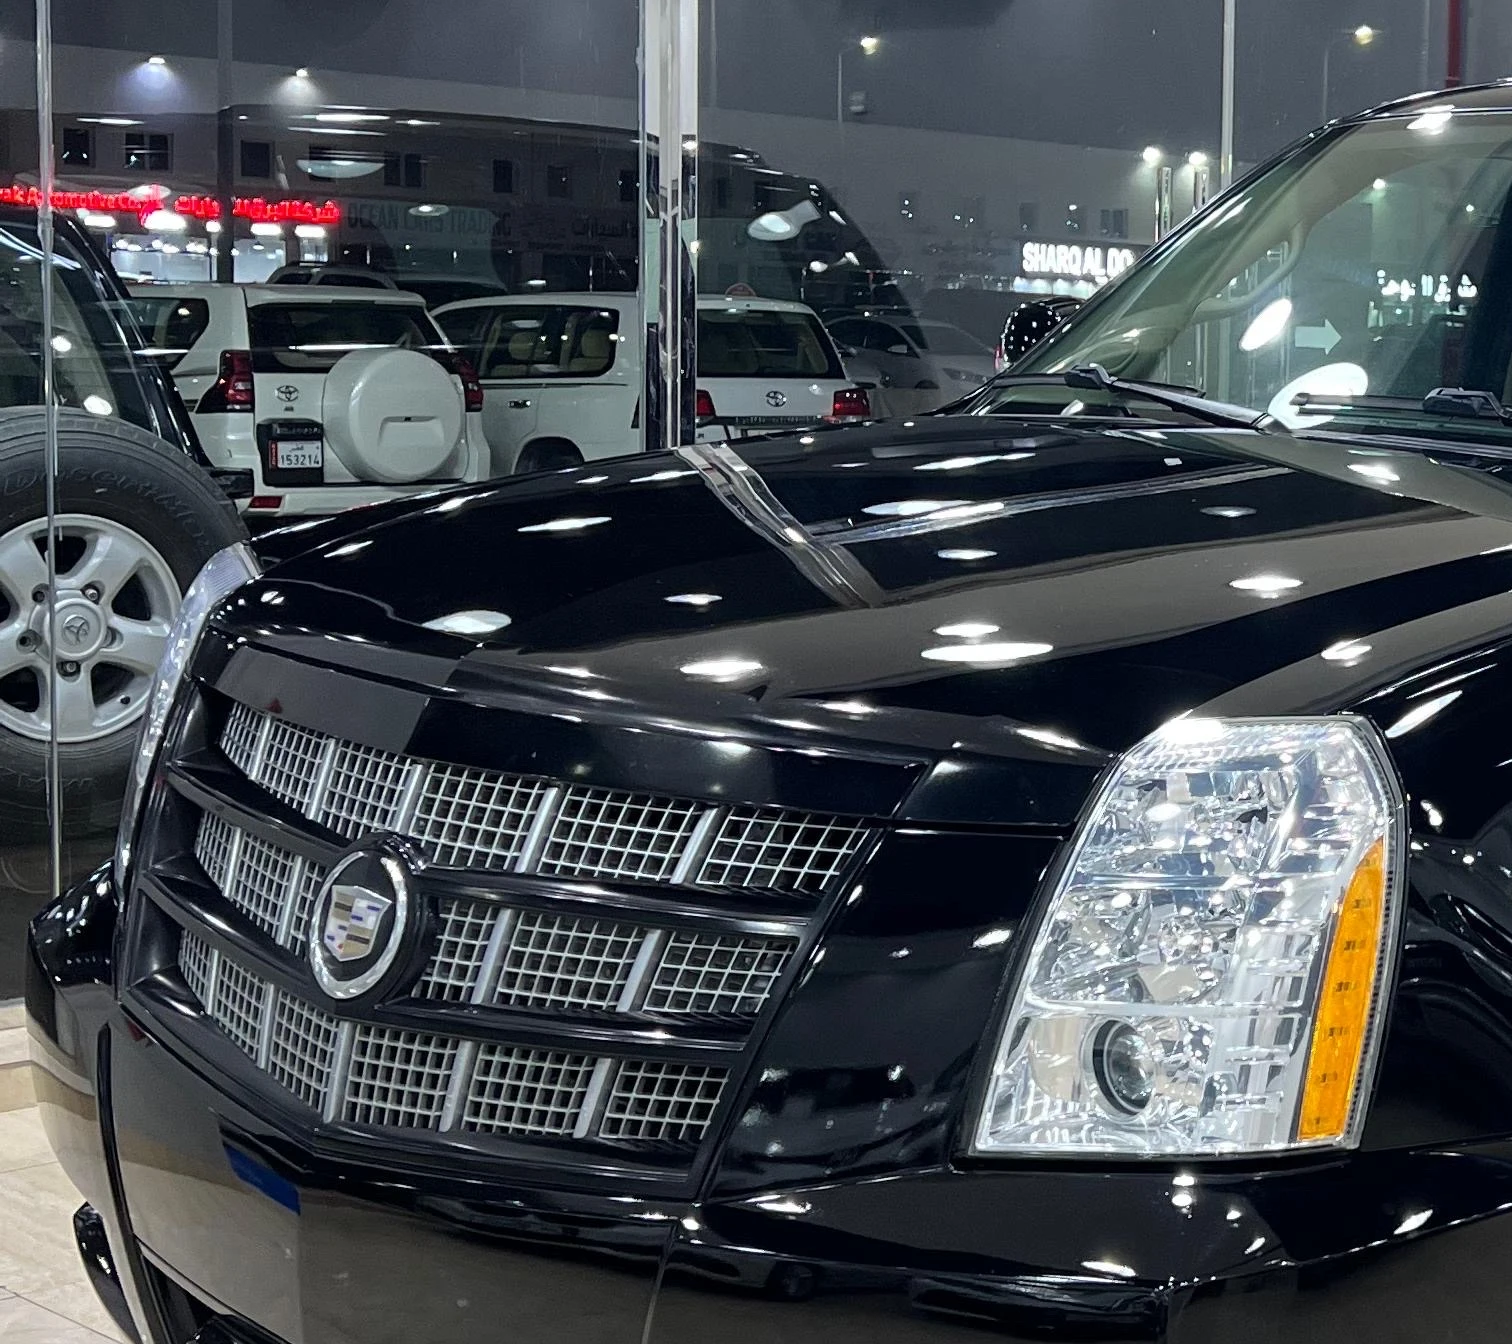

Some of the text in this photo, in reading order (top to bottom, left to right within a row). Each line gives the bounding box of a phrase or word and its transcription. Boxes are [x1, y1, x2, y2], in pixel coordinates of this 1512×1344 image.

[26, 186, 116, 210] Auomotive
[1022, 241, 1081, 276] SHARQ
[1083, 246, 1106, 276] AL
[280, 454, 320, 466] 153214
